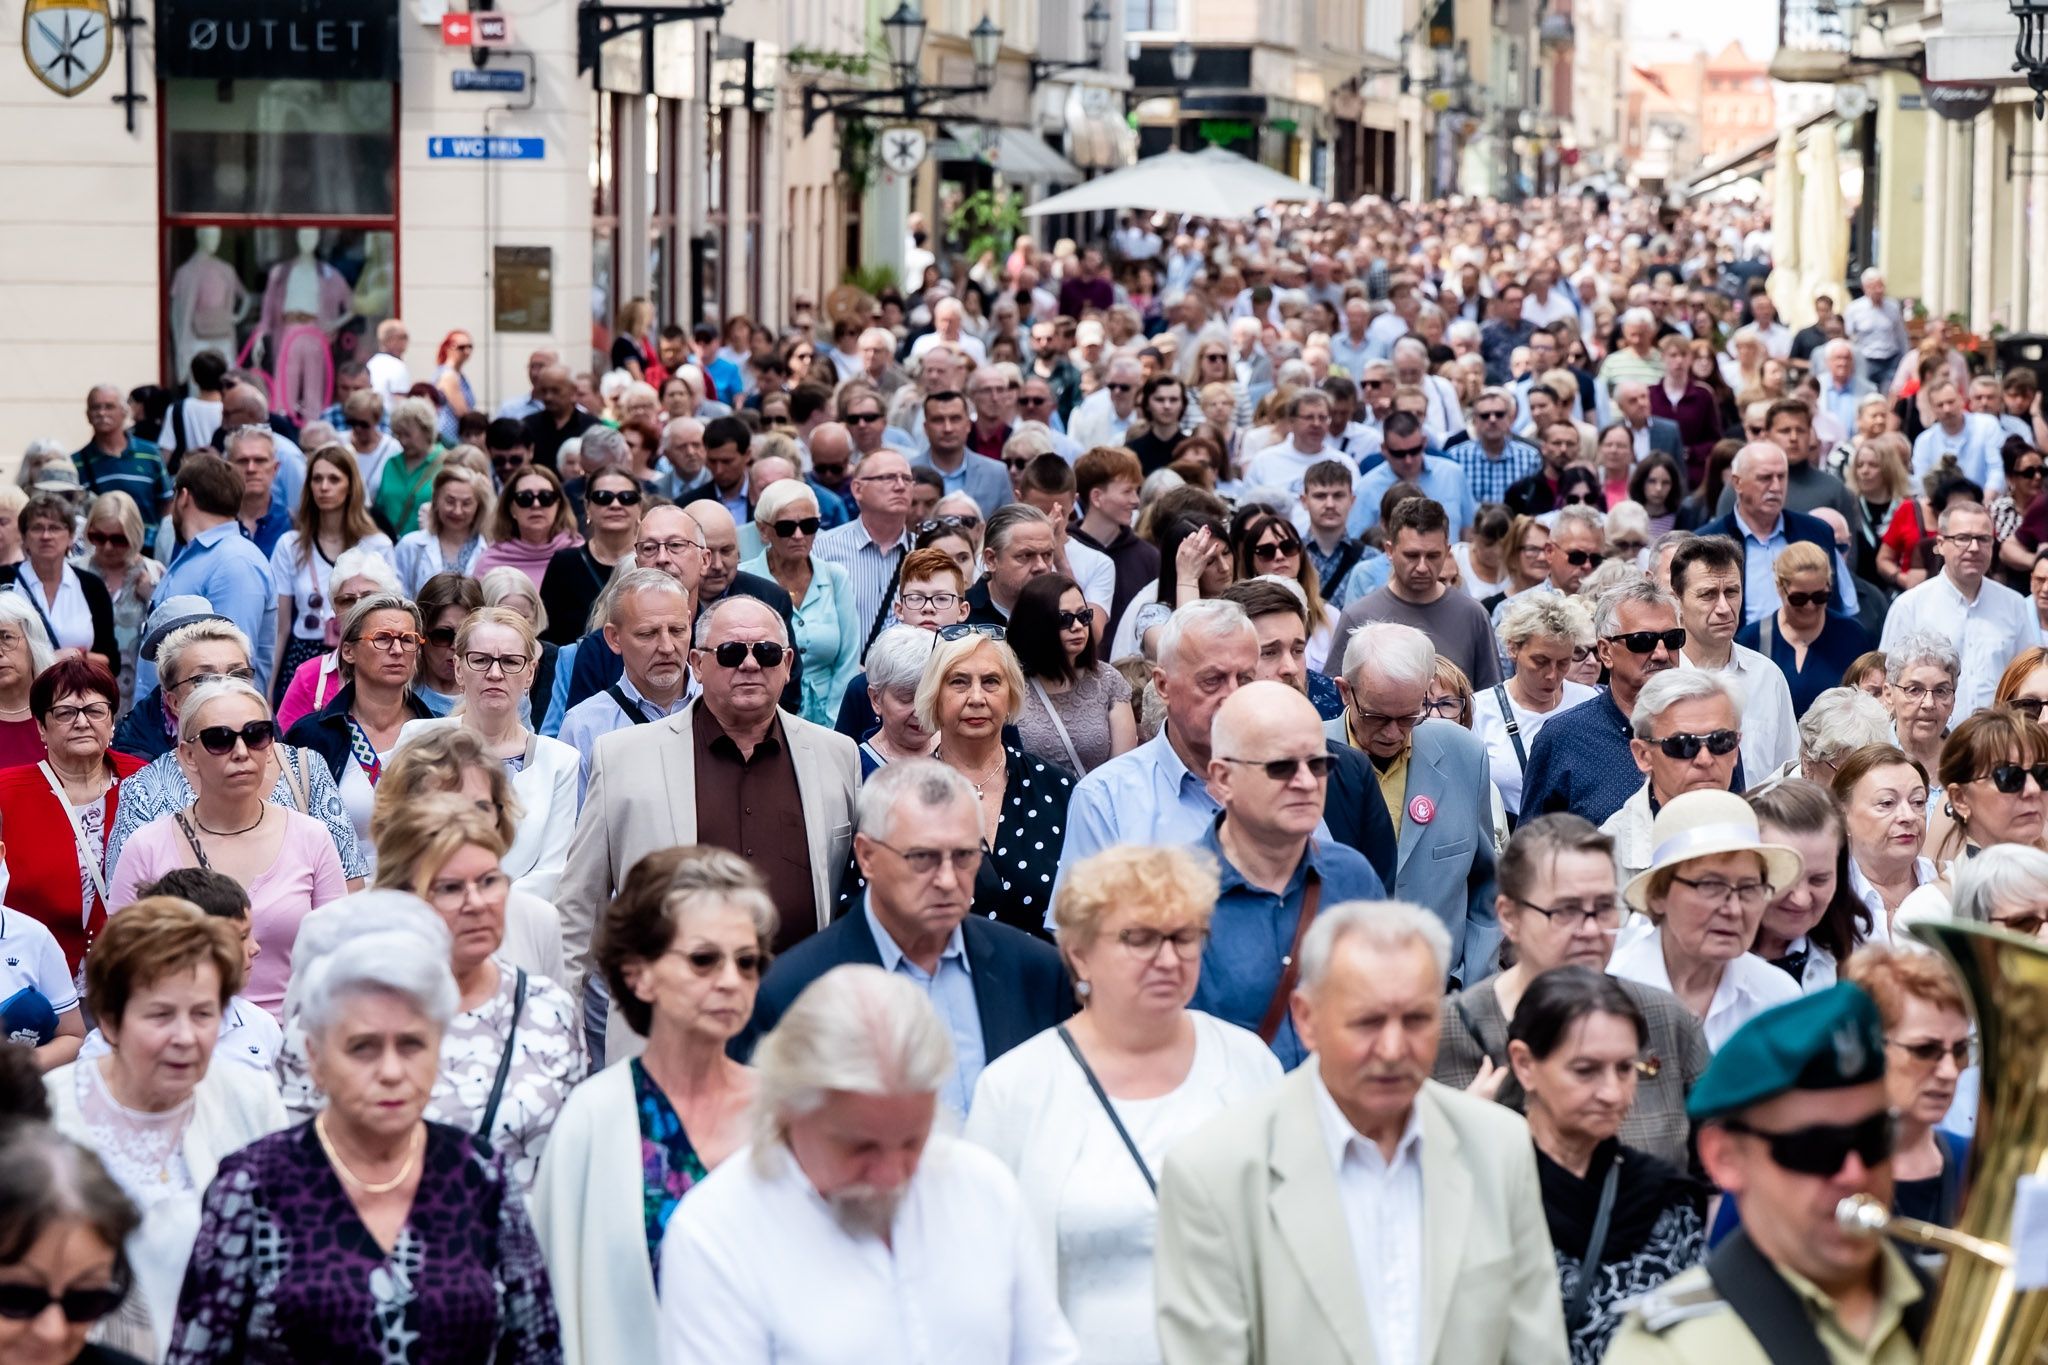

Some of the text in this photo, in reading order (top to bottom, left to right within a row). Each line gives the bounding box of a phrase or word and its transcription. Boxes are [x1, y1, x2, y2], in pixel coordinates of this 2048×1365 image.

[189, 19, 365, 51] ØUTLET
[481, 22, 504, 36] WC
[452, 139, 486, 157] WC
